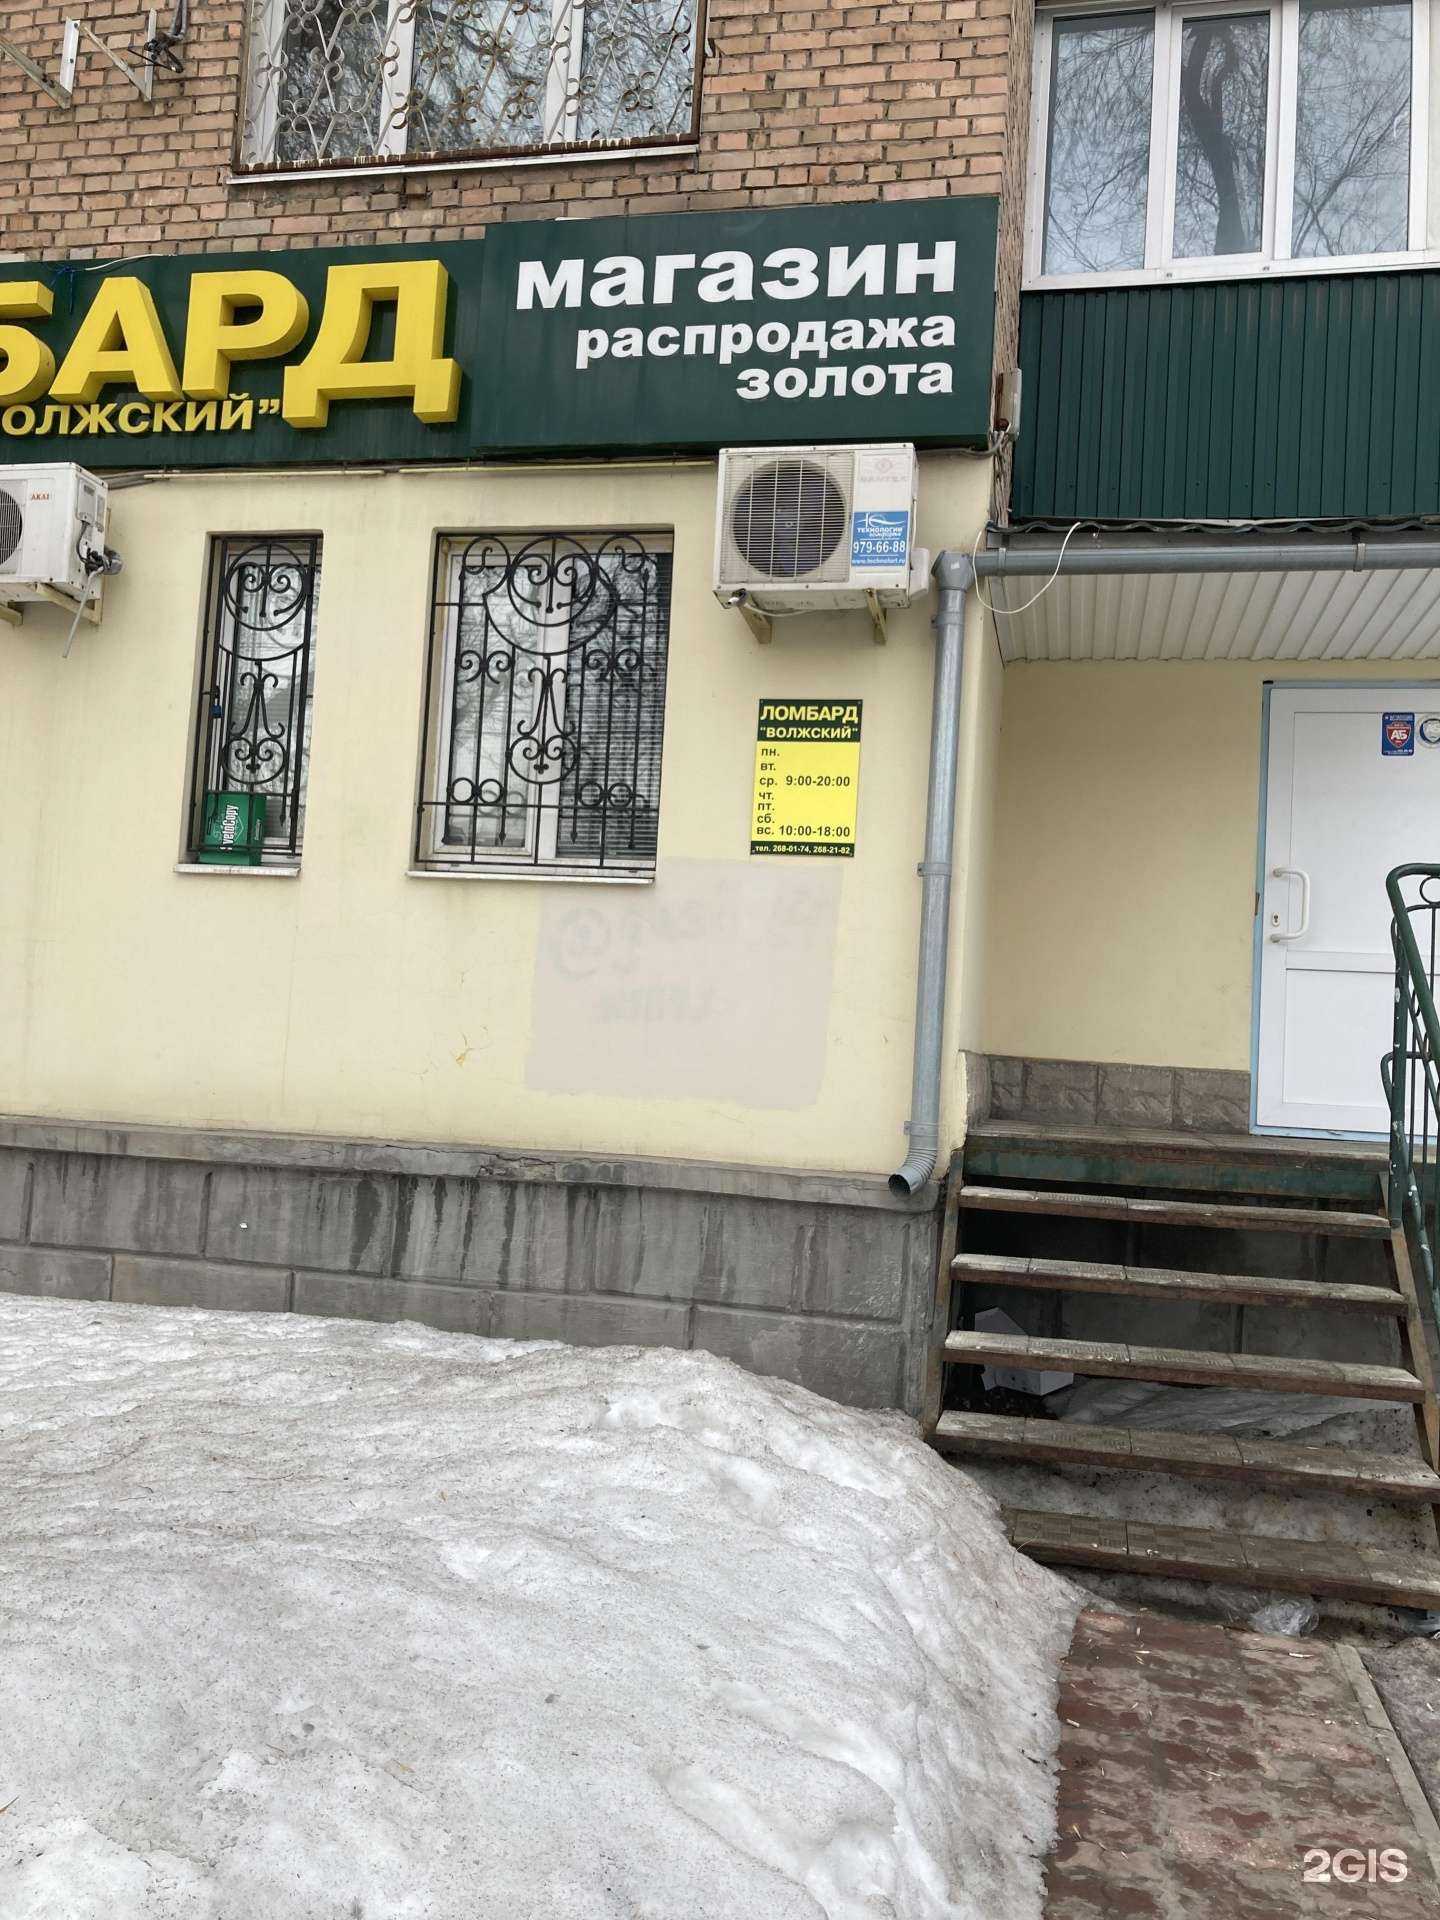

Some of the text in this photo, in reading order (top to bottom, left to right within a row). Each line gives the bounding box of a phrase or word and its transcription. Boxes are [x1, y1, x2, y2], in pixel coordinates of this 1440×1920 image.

[516, 240, 956, 310] магазин
[575, 314, 956, 369] распродажа
[736, 362, 953, 399] золота
[760, 705, 858, 724] ЛОМБАРД
[760, 725, 858, 739] "ВОЛЖСКИЙ"
[759, 775, 850, 787] ср. 9:00-20:00
[757, 813, 775, 823] сб.
[778, 825, 850, 837] 10:00-18:00
